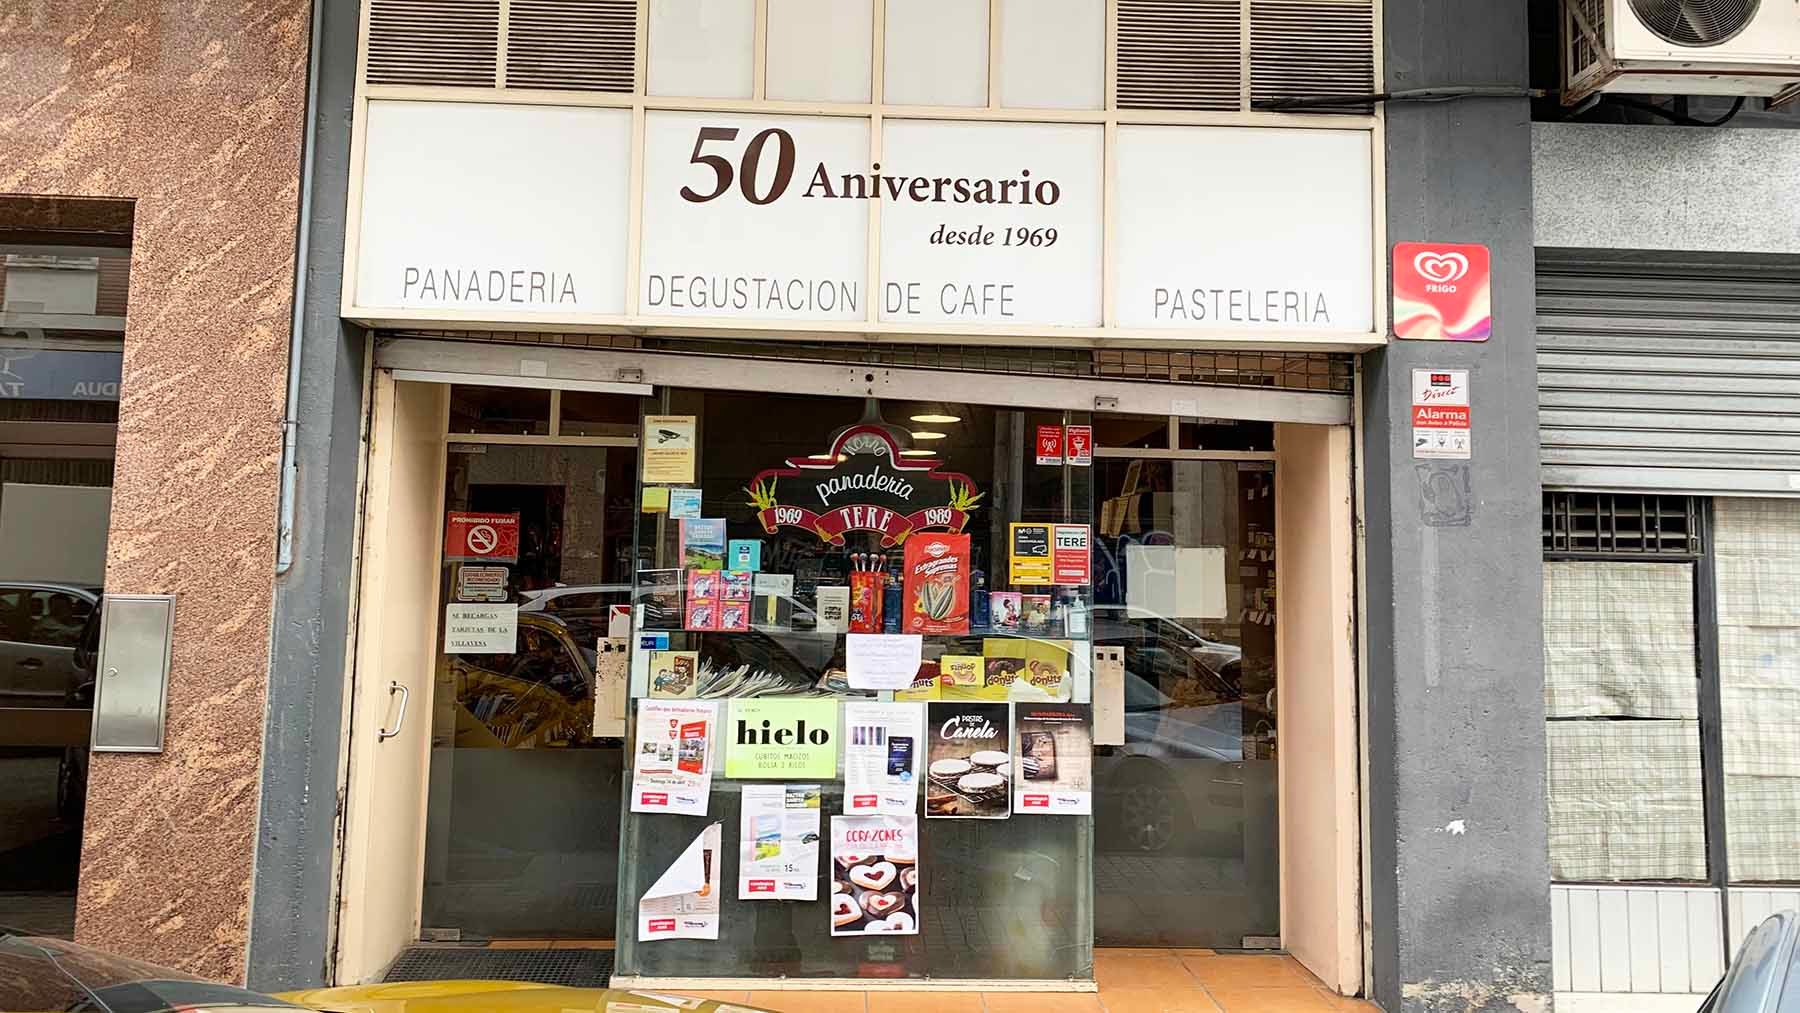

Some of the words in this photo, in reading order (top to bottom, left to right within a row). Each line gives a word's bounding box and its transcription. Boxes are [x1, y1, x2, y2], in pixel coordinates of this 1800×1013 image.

[680, 127, 796, 205] 50
[803, 161, 1061, 207] Aniversario
[930, 224, 994, 247] desde
[1003, 227, 1058, 249] 1969
[403, 267, 577, 304] PANADERIA
[648, 274, 858, 314] DEGUSTACION
[886, 281, 922, 315] DE
[941, 282, 1015, 316] CAFE
[1426, 284, 1457, 293] FRIGO
[1154, 288, 1330, 323] PASTELERIA
[1417, 408, 1466, 419] Alarma
[816, 465, 914, 506] panaderia
[774, 508, 803, 525] 1969
[840, 506, 894, 532] TERE
[924, 508, 952, 525] 1989
[1056, 537, 1087, 547] TERE
[736, 719, 830, 746] hielo
[940, 715, 999, 740] Canela
[846, 828, 904, 843] CORAZONES
